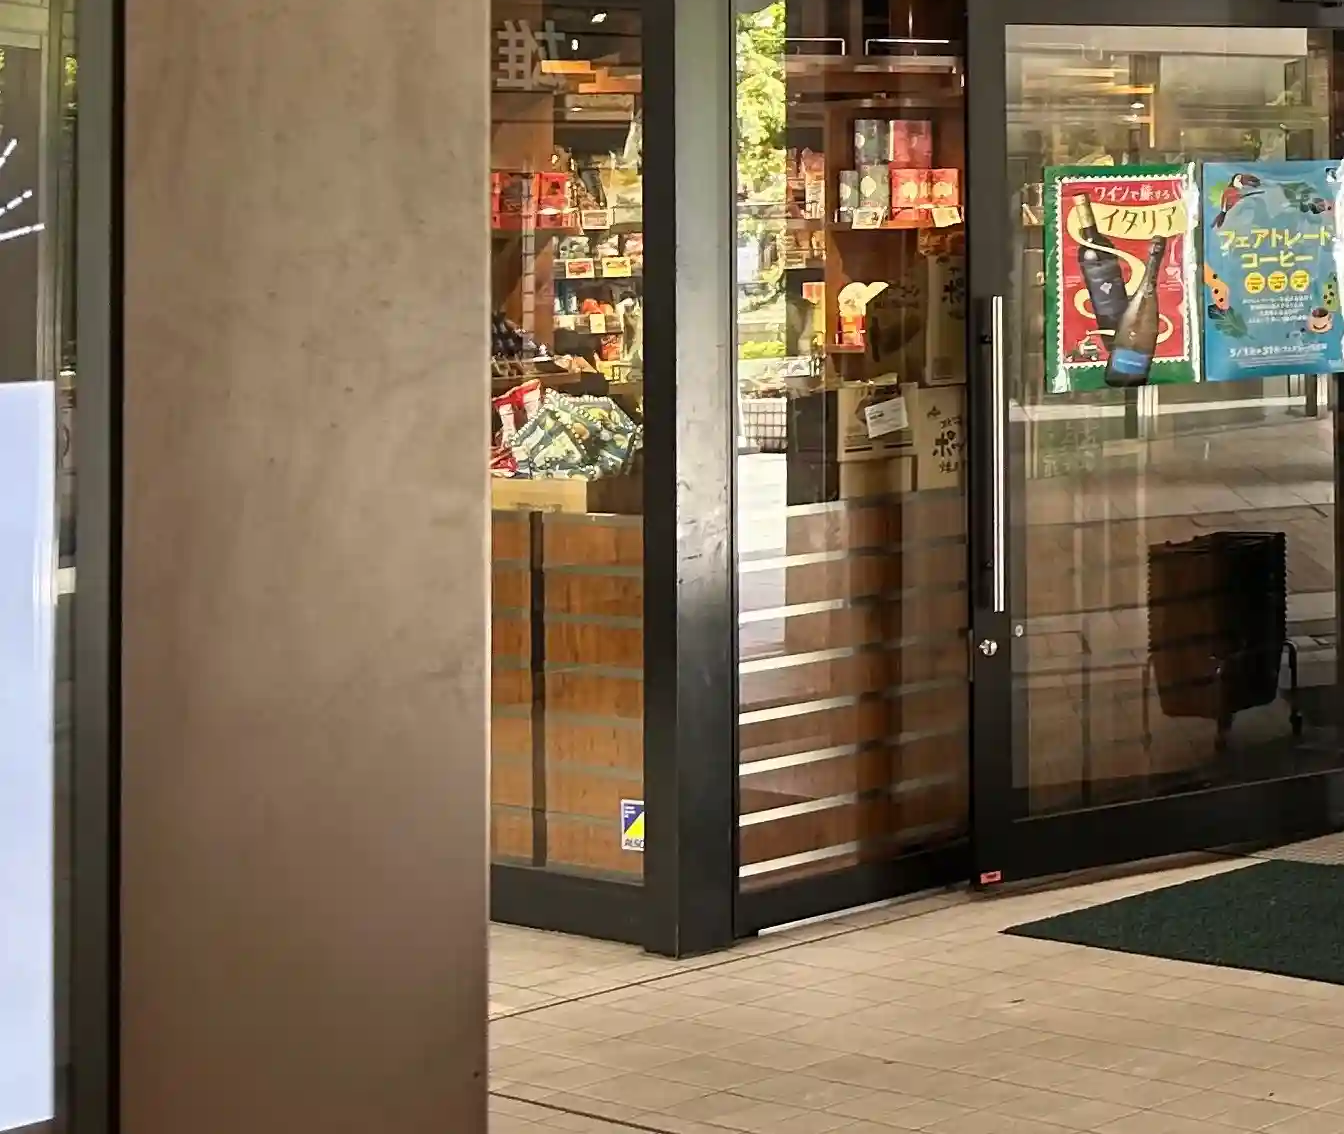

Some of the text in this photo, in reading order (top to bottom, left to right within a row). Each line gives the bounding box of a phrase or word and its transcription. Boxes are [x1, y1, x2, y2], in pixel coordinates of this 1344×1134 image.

[1101, 206, 1177, 235] イタリア
[1217, 226, 1334, 255] フェアトレード
[1240, 250, 1313, 268] コーヒー
